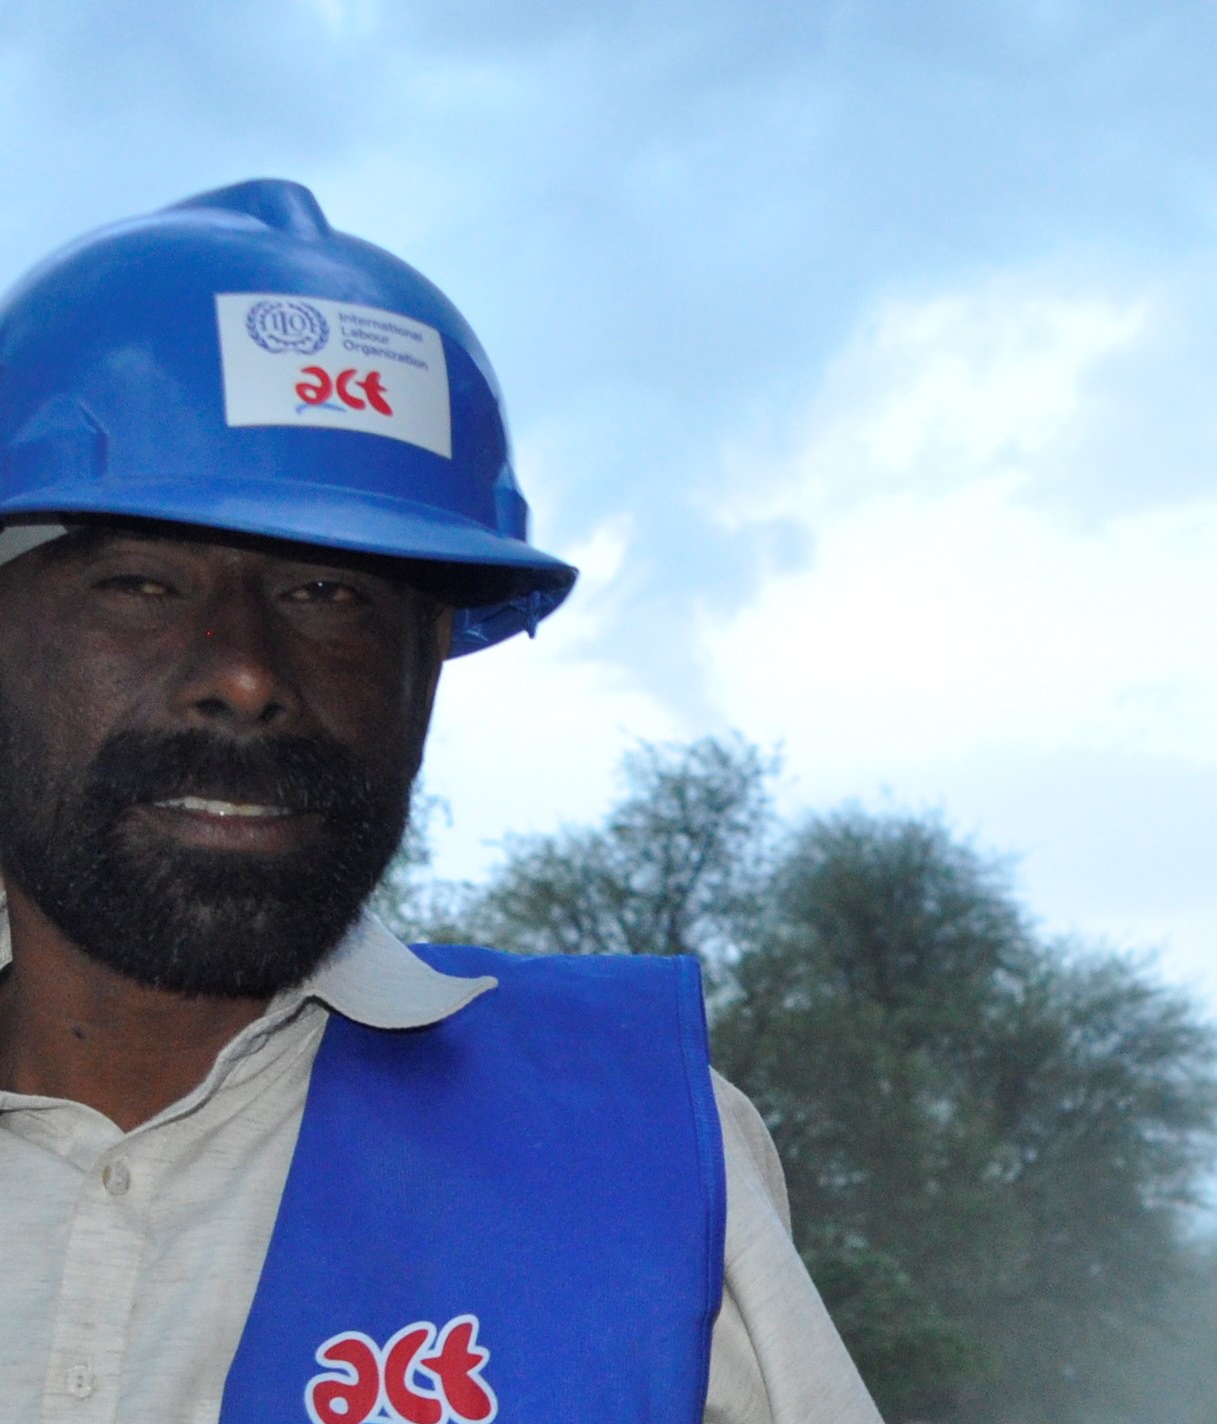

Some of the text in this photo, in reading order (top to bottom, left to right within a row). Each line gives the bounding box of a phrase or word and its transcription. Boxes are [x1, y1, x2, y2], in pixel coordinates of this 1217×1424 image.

[339, 312, 423, 342] International
[341, 325, 389, 345] Labour
[343, 338, 429, 371] Organization
[294, 365, 394, 417] act
